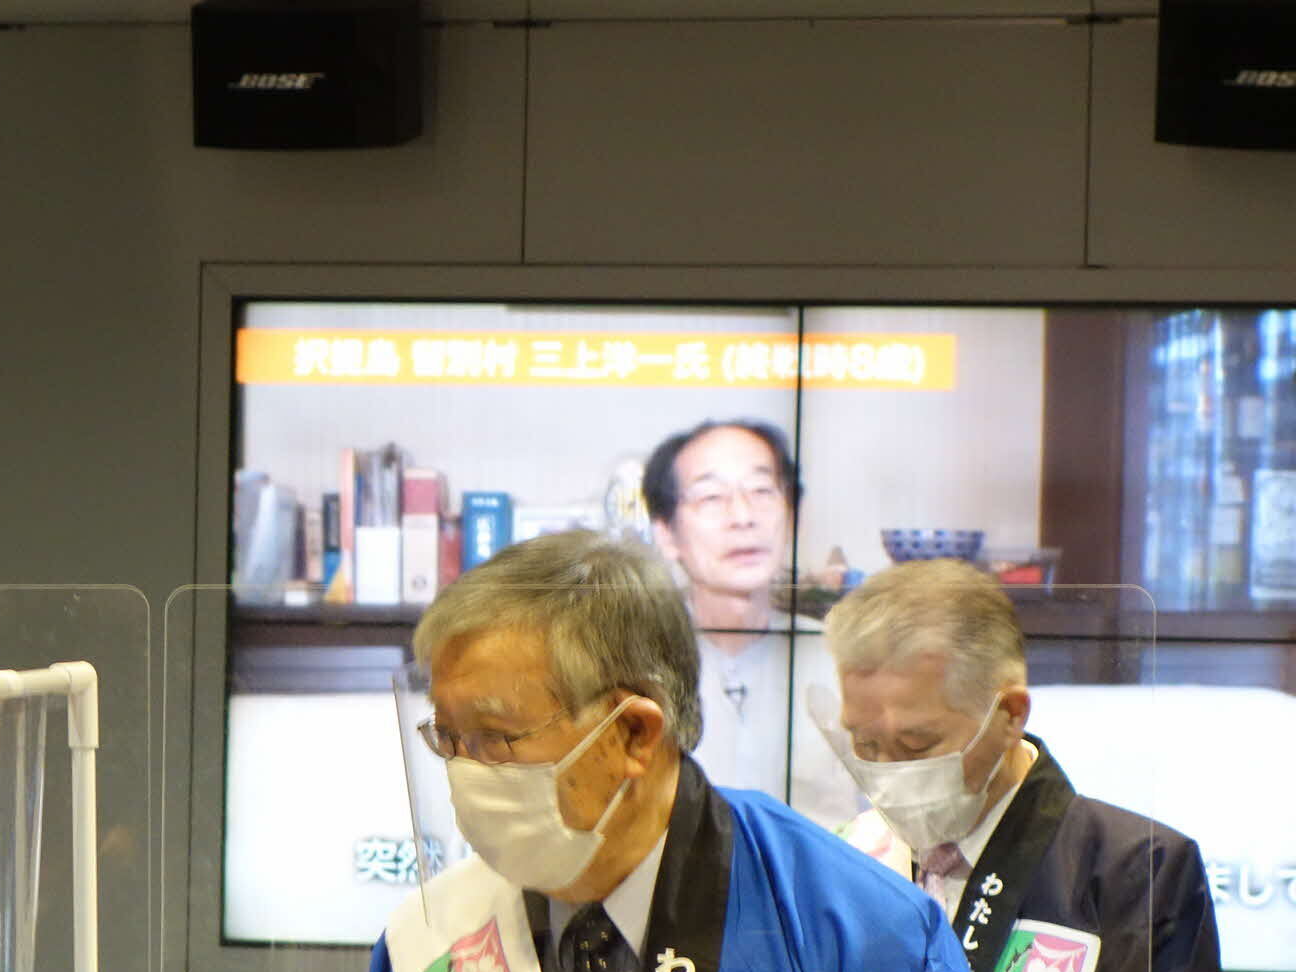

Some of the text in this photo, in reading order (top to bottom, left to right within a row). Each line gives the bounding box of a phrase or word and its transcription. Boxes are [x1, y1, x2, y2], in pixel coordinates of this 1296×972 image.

[227, 72, 326, 91] BOSE
[963, 872, 1004, 951] わたし
